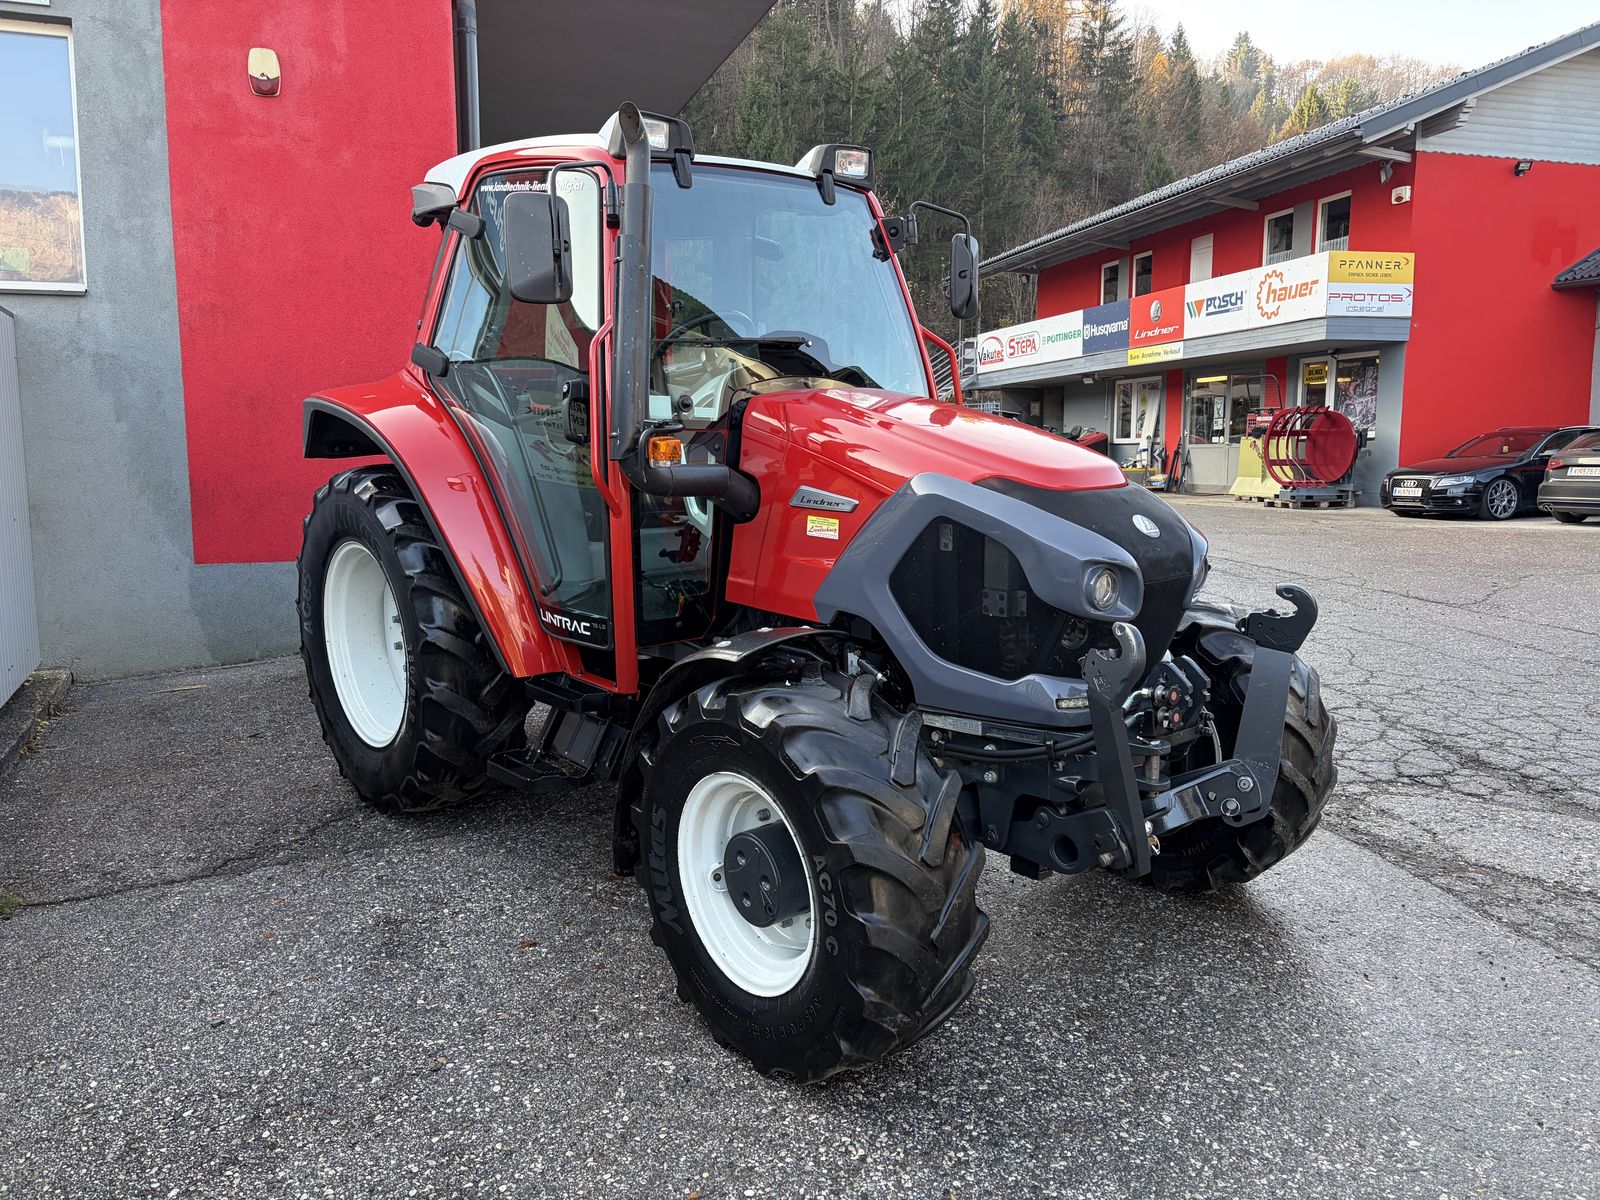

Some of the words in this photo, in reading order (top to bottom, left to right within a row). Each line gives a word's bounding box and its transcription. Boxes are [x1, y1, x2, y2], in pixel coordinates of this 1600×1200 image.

[1339, 260, 1401, 270] PFANNER
[1265, 279, 1319, 304] hauer
[1328, 293, 1404, 303] PROTOS
[1205, 291, 1244, 312] POSCH
[1345, 305, 1385, 313] integral
[1090, 320, 1128, 337] Husqvarna
[1133, 326, 1179, 340] Lindner
[977, 346, 1005, 366] Vakutec
[800, 495, 845, 507] Lindner
[539, 608, 591, 636] LINTRAC
[811, 854, 838, 928] AC70
